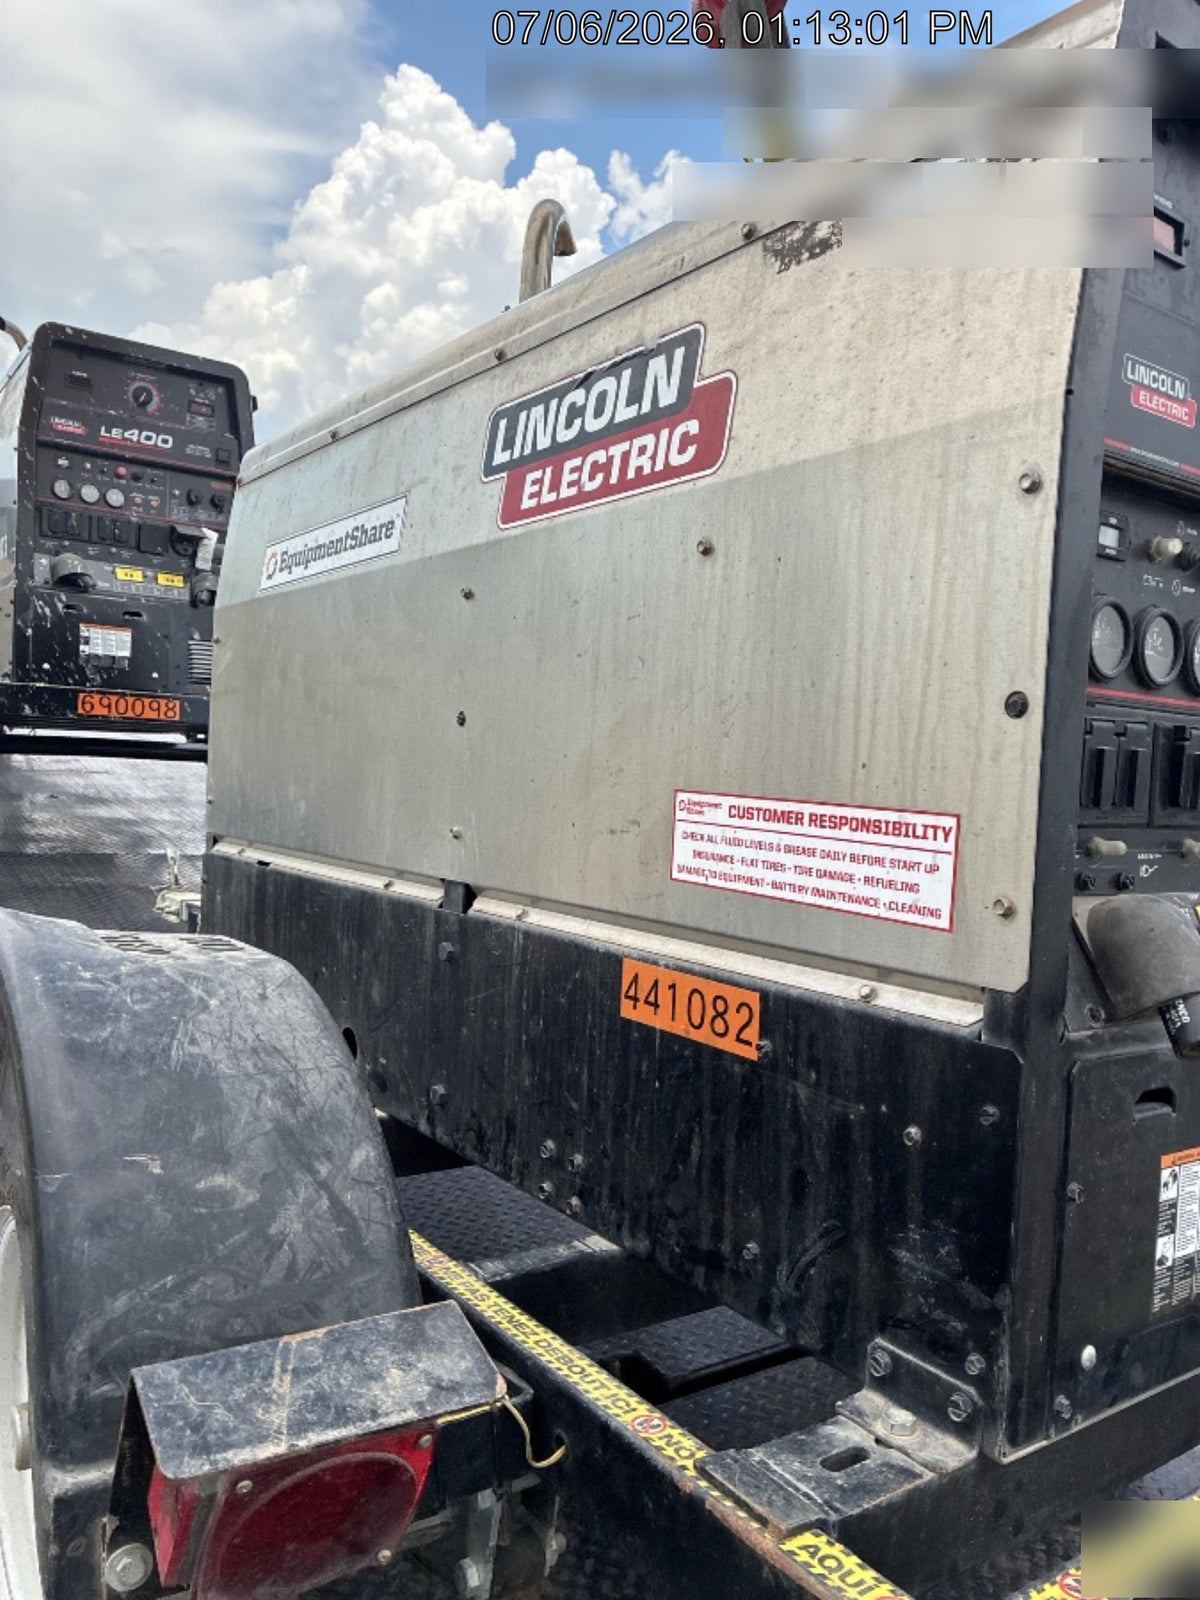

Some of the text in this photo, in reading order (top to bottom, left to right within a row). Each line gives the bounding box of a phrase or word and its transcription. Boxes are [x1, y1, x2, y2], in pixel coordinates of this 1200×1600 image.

[1126, 360, 1186, 400] LINCOLN
[492, 346, 685, 467] LINCOLN
[1139, 390, 1189, 421] ELECTRIC
[100, 425, 174, 449] LE400
[520, 419, 700, 511] ELECTRIC
[278, 519, 395, 575] EquipmentShare
[81, 694, 177, 719] 690098
[728, 804, 953, 843] CUSTOMER RESPONSIBILITY
[682, 831, 705, 842] CHECK
[706, 834, 719, 845] ALL
[745, 838, 774, 852] LEVELS
[784, 844, 817, 858] GREASE
[820, 849, 847, 862] DAILY
[849, 852, 887, 868] BEFORE
[889, 858, 922, 873] START
[924, 863, 940, 875] UP
[693, 849, 920, 894] INSURANCE FLAT TIRES TIRE DAMAGE REFUELING
[718, 870, 765, 888] EQUIPMENT
[771, 879, 809, 896] BATTERY
[811, 886, 881, 909] MAINTENANCE
[888, 900, 942, 919] CLEANING
[623, 972, 754, 1047] 441082
[459, 1280, 491, 1300] PAS
[486, 1301, 538, 1339] TENEZ
[534, 1338, 611, 1392] DEBOUT
[607, 1393, 637, 1415] ICI
[659, 1433, 696, 1460] NO
